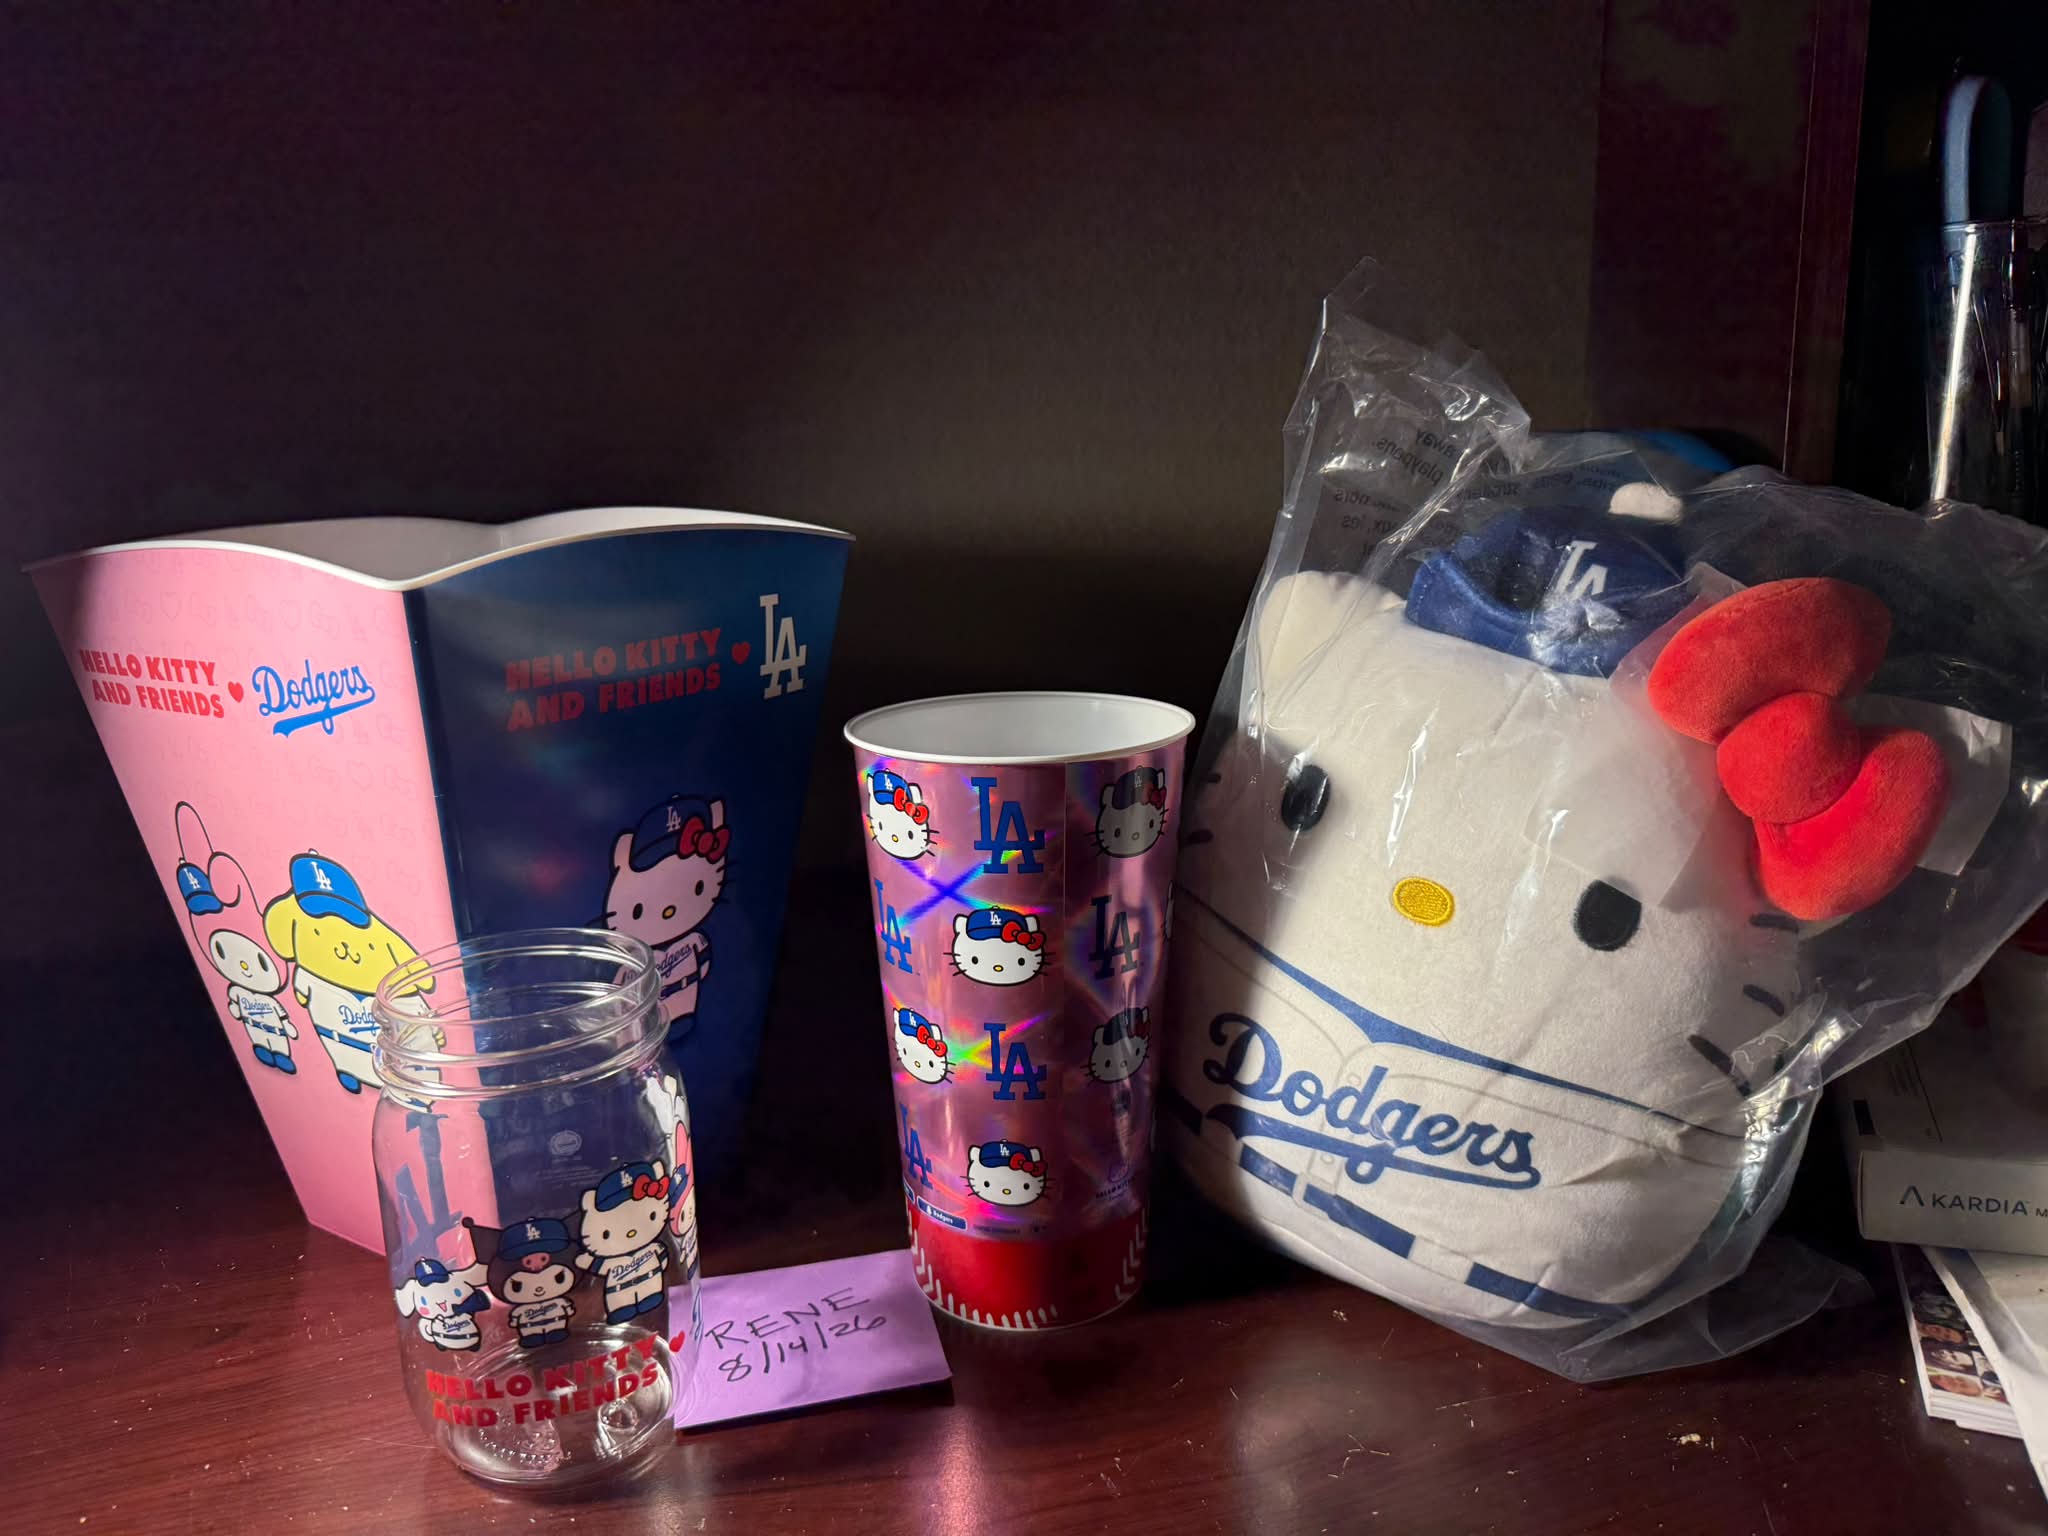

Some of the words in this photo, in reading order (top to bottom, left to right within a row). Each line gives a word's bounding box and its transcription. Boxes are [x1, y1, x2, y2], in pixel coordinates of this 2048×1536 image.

[79, 649, 142, 680] HELLO
[146, 655, 217, 687] KITTY
[505, 646, 617, 692] HELLO
[625, 628, 722, 673] KITTY
[759, 593, 808, 699] LA
[92, 678, 132, 707] AND
[137, 685, 225, 719] FRIENDS
[252, 659, 376, 738] Dodgers
[507, 691, 585, 732] AND
[599, 664, 721, 713] FRIENDS
[666, 806, 681, 832] LA
[971, 776, 1046, 874] LA
[183, 867, 201, 889] LA
[311, 861, 334, 891] LA
[874, 879, 914, 975] LA
[1088, 895, 1142, 981] LA
[650, 943, 693, 978] odgers
[338, 1004, 380, 1036] Dodg
[984, 1023, 1047, 1100] LA
[1203, 1012, 1541, 1189] Dodgers
[901, 1103, 933, 1190] LA
[525, 1223, 541, 1241] LA
[1931, 1192, 2028, 1216] KARDIA
[612, 1249, 655, 1281] Dodgers
[705, 1287, 870, 1350] RENE
[718, 1315, 886, 1383] 8/14/26
[425, 1369, 532, 1401] HELLO
[544, 1331, 659, 1392] KITTY
[433, 1399, 498, 1428] AND
[514, 1363, 659, 1425] FRIENDS
